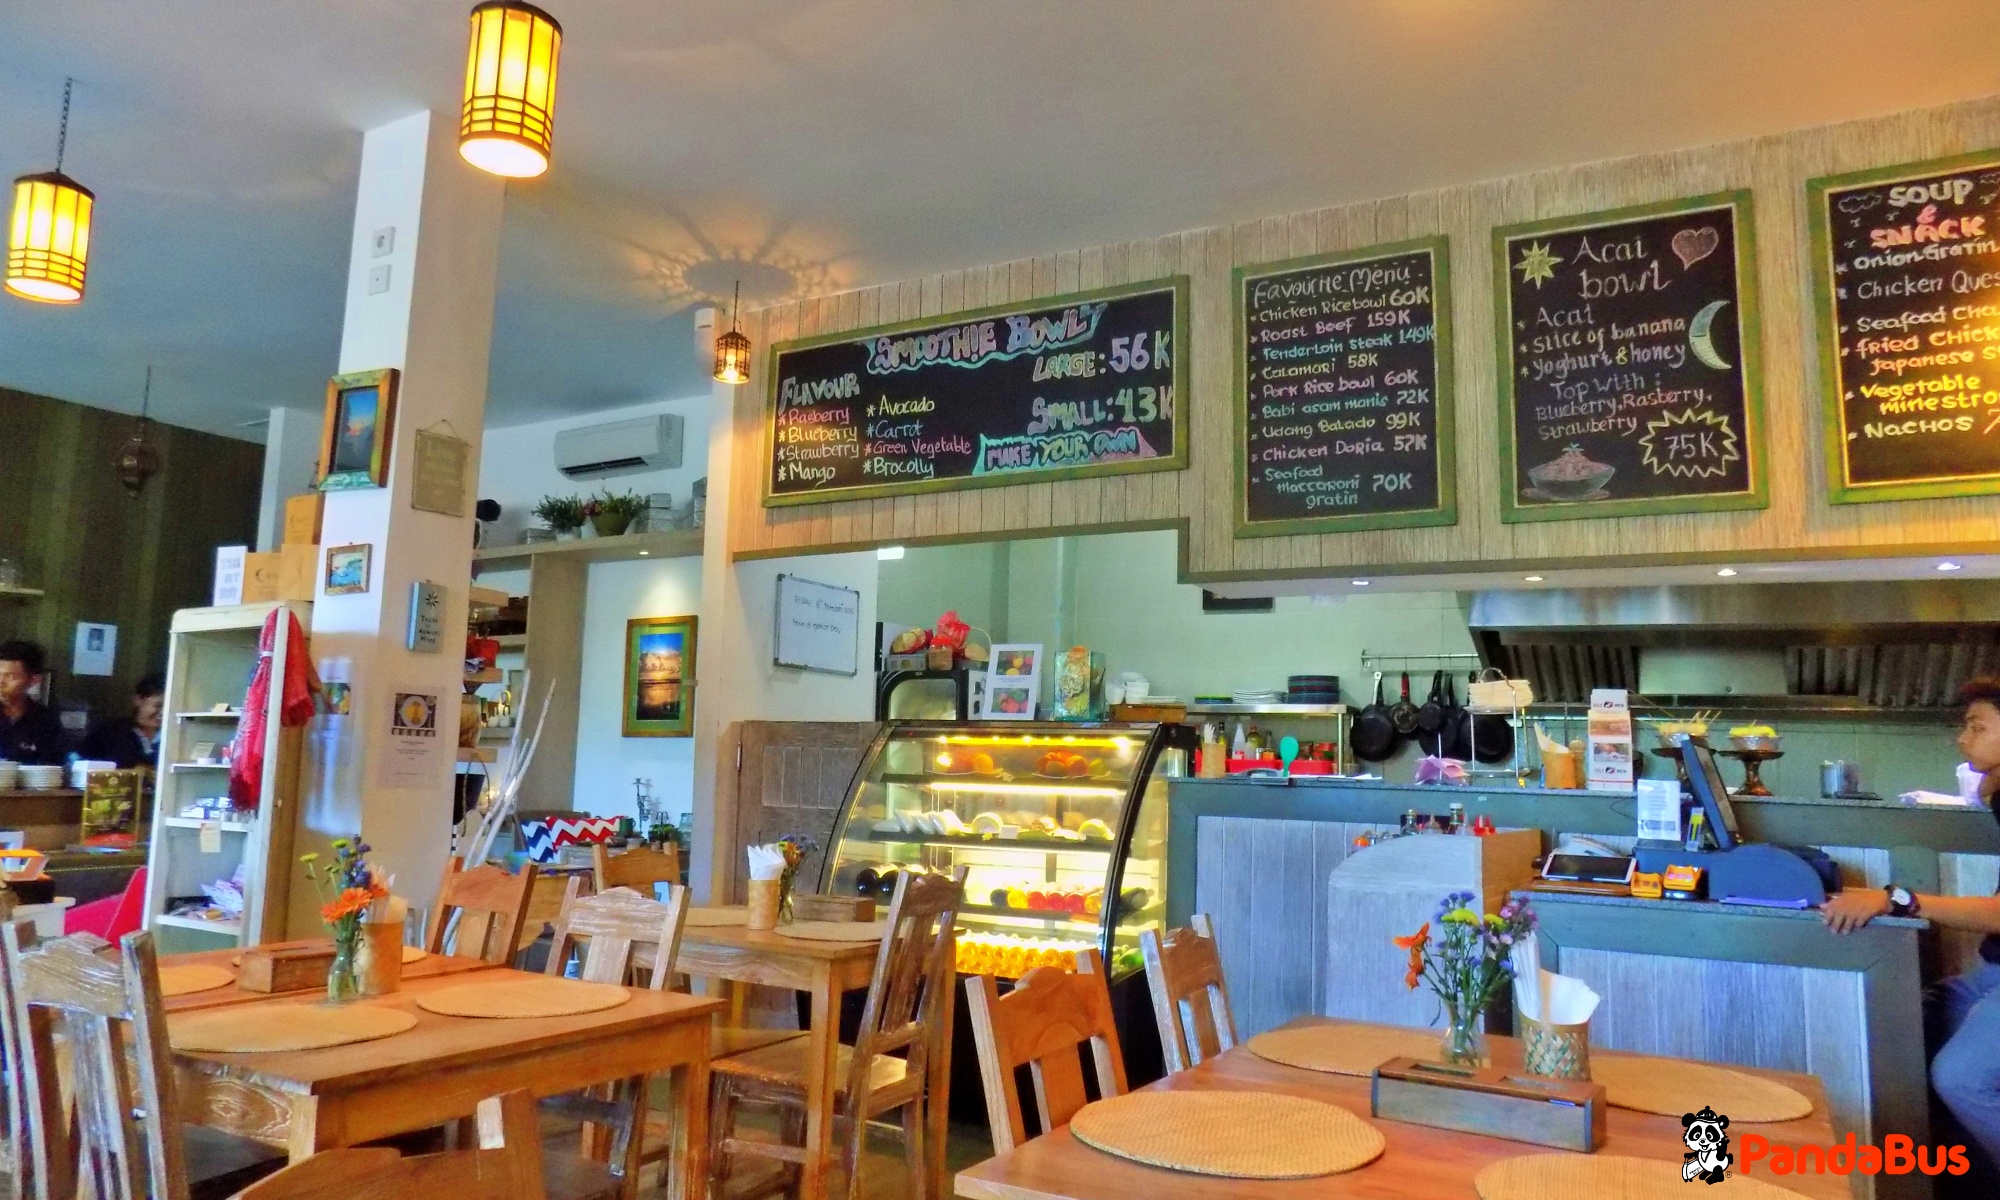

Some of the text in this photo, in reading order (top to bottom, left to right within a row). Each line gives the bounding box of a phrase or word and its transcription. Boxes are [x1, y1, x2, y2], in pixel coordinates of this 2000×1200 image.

[1889, 179, 1973, 207] SOUP
[1870, 215, 1985, 248] SNACK
[1572, 235, 1649, 265] Acai
[1254, 266, 1410, 309] Favourite Menu
[1577, 259, 1674, 300] bowl
[1857, 275, 1943, 299] Chicken
[1259, 307, 1317, 323] Chicken
[1389, 286, 1430, 307] 60K
[1535, 303, 1596, 327] Acai
[1857, 305, 1946, 332] Seafood
[1261, 327, 1309, 343] Roast
[1587, 328, 1605, 351] of
[1610, 317, 1686, 340] banana
[1630, 342, 1686, 369] honey
[1550, 380, 1589, 402] Top
[789, 407, 849, 425] Rasberry
[879, 394, 934, 416] Avocado
[788, 426, 857, 443] Blueberry
[875, 419, 923, 439] Carrot
[1538, 415, 1637, 440] Strawberry
[786, 442, 859, 462] Strawberry
[873, 435, 972, 459] Green Vegetable
[1263, 444, 1327, 462] Chicken
[1664, 430, 1719, 459] 75K
[790, 462, 835, 487] Mango
[873, 456, 934, 479] Brocolly
[1265, 464, 1323, 481] Seafood
[1306, 491, 1358, 509] gratin
